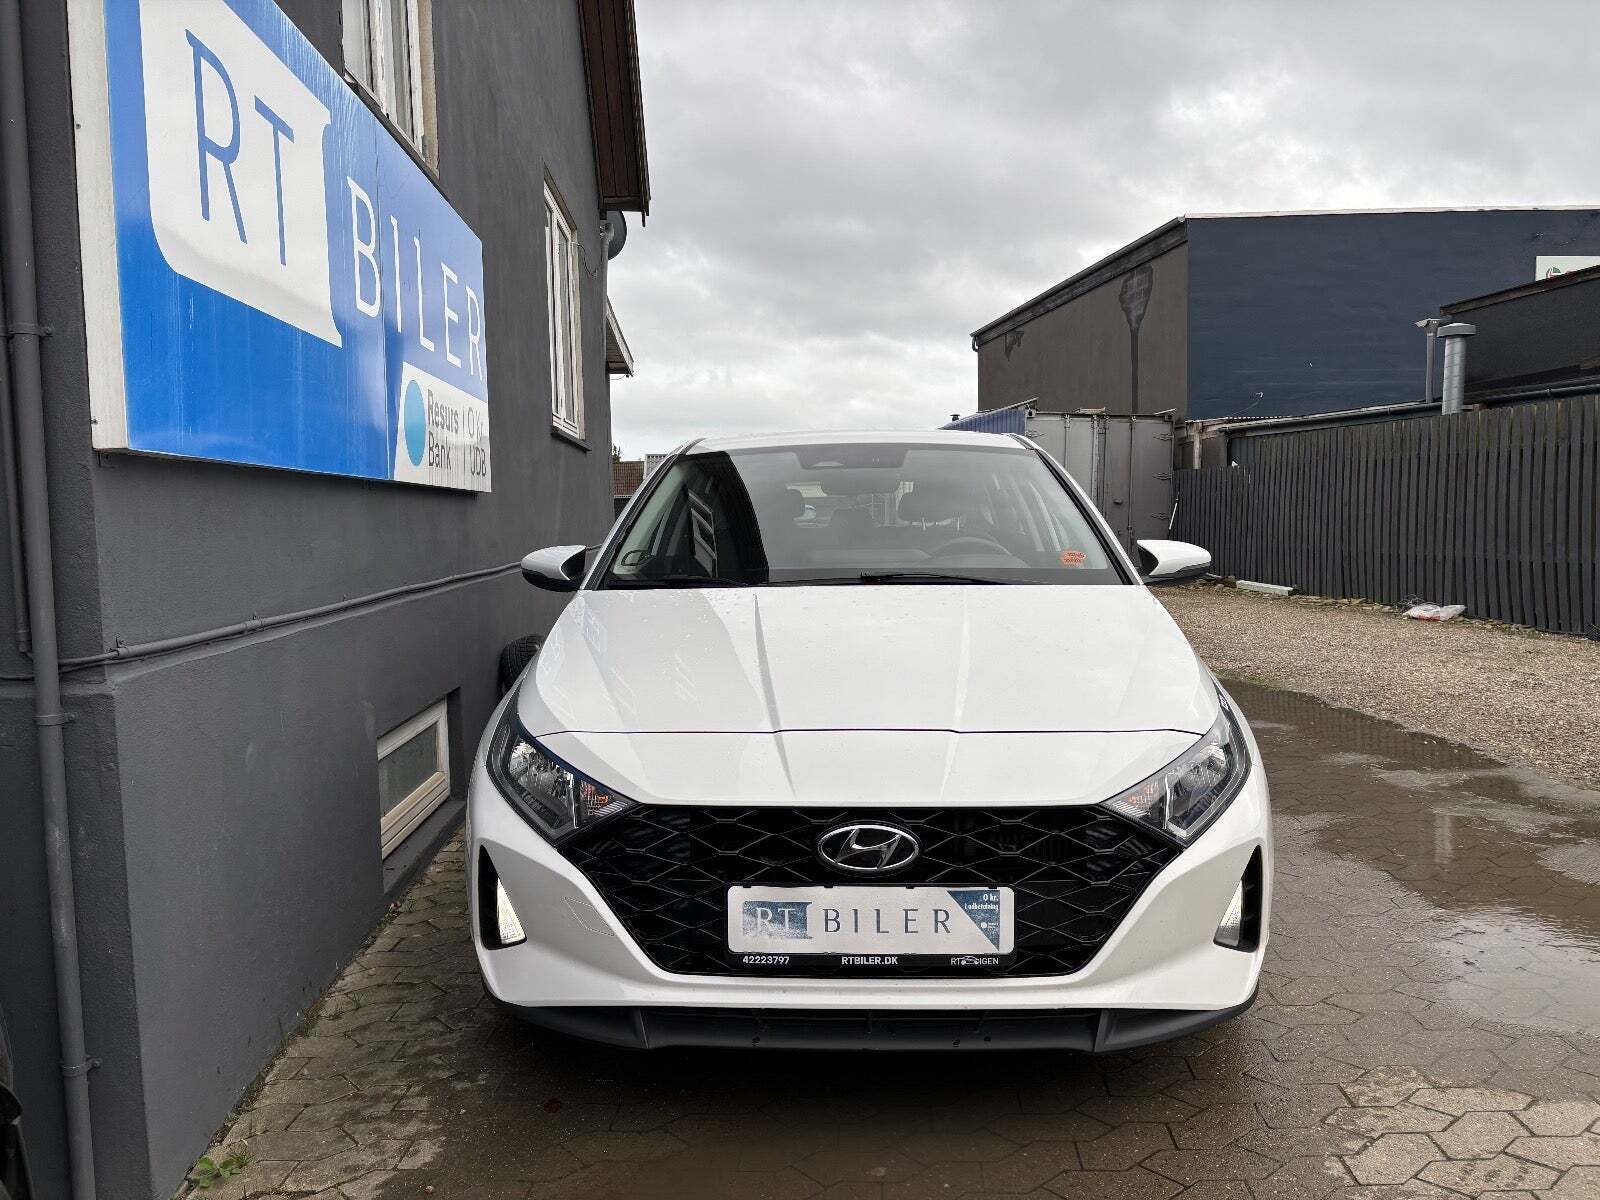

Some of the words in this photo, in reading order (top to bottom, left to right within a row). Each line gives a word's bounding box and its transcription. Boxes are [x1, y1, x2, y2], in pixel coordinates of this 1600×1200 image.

[184, 28, 295, 267] RT
[346, 175, 484, 381] BILER
[428, 389, 459, 434] Resurs
[428, 431, 452, 470] Bank
[755, 907, 796, 934] RT
[822, 908, 951, 934] BILER
[742, 955, 790, 965] 42223797
[841, 956, 898, 966] RTBILER.DK
